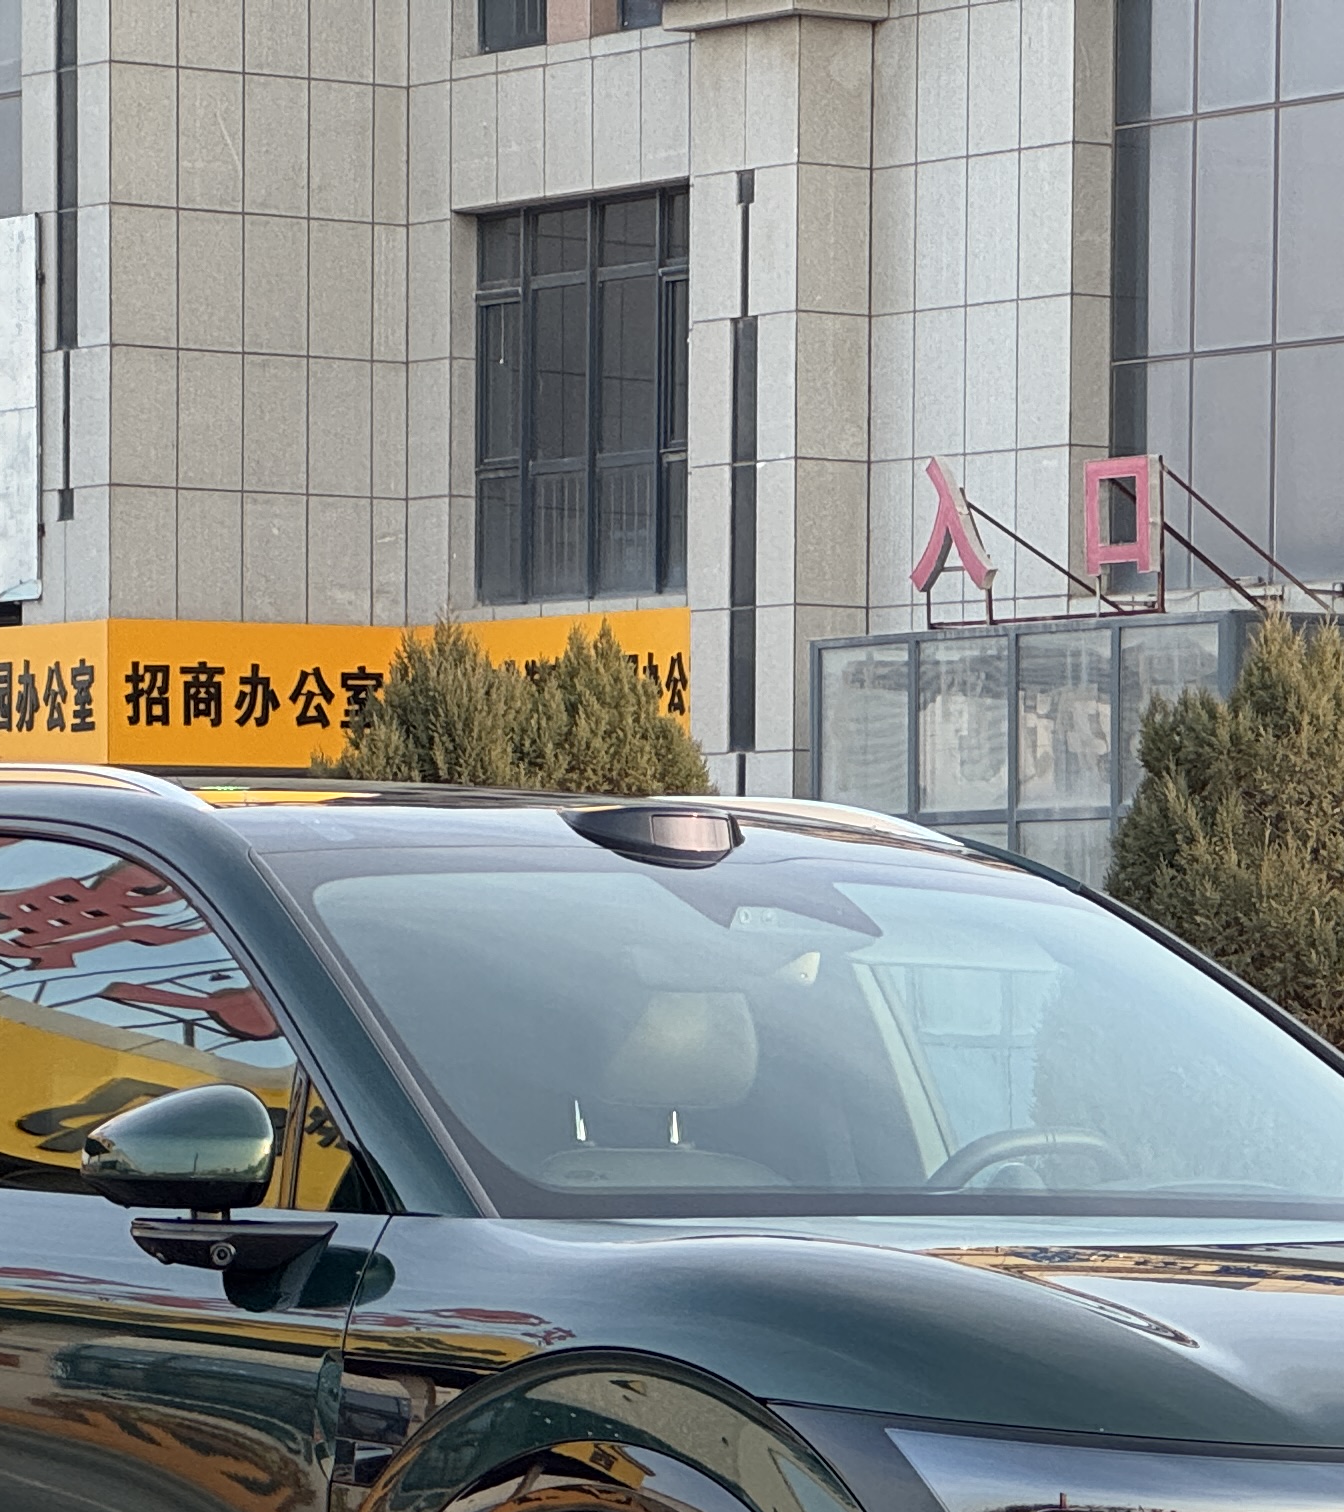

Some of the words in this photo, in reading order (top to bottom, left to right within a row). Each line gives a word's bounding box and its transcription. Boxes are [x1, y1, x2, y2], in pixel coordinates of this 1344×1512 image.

[910, 454, 1165, 592] 入口
[125, 660, 385, 729] 招商办公室
